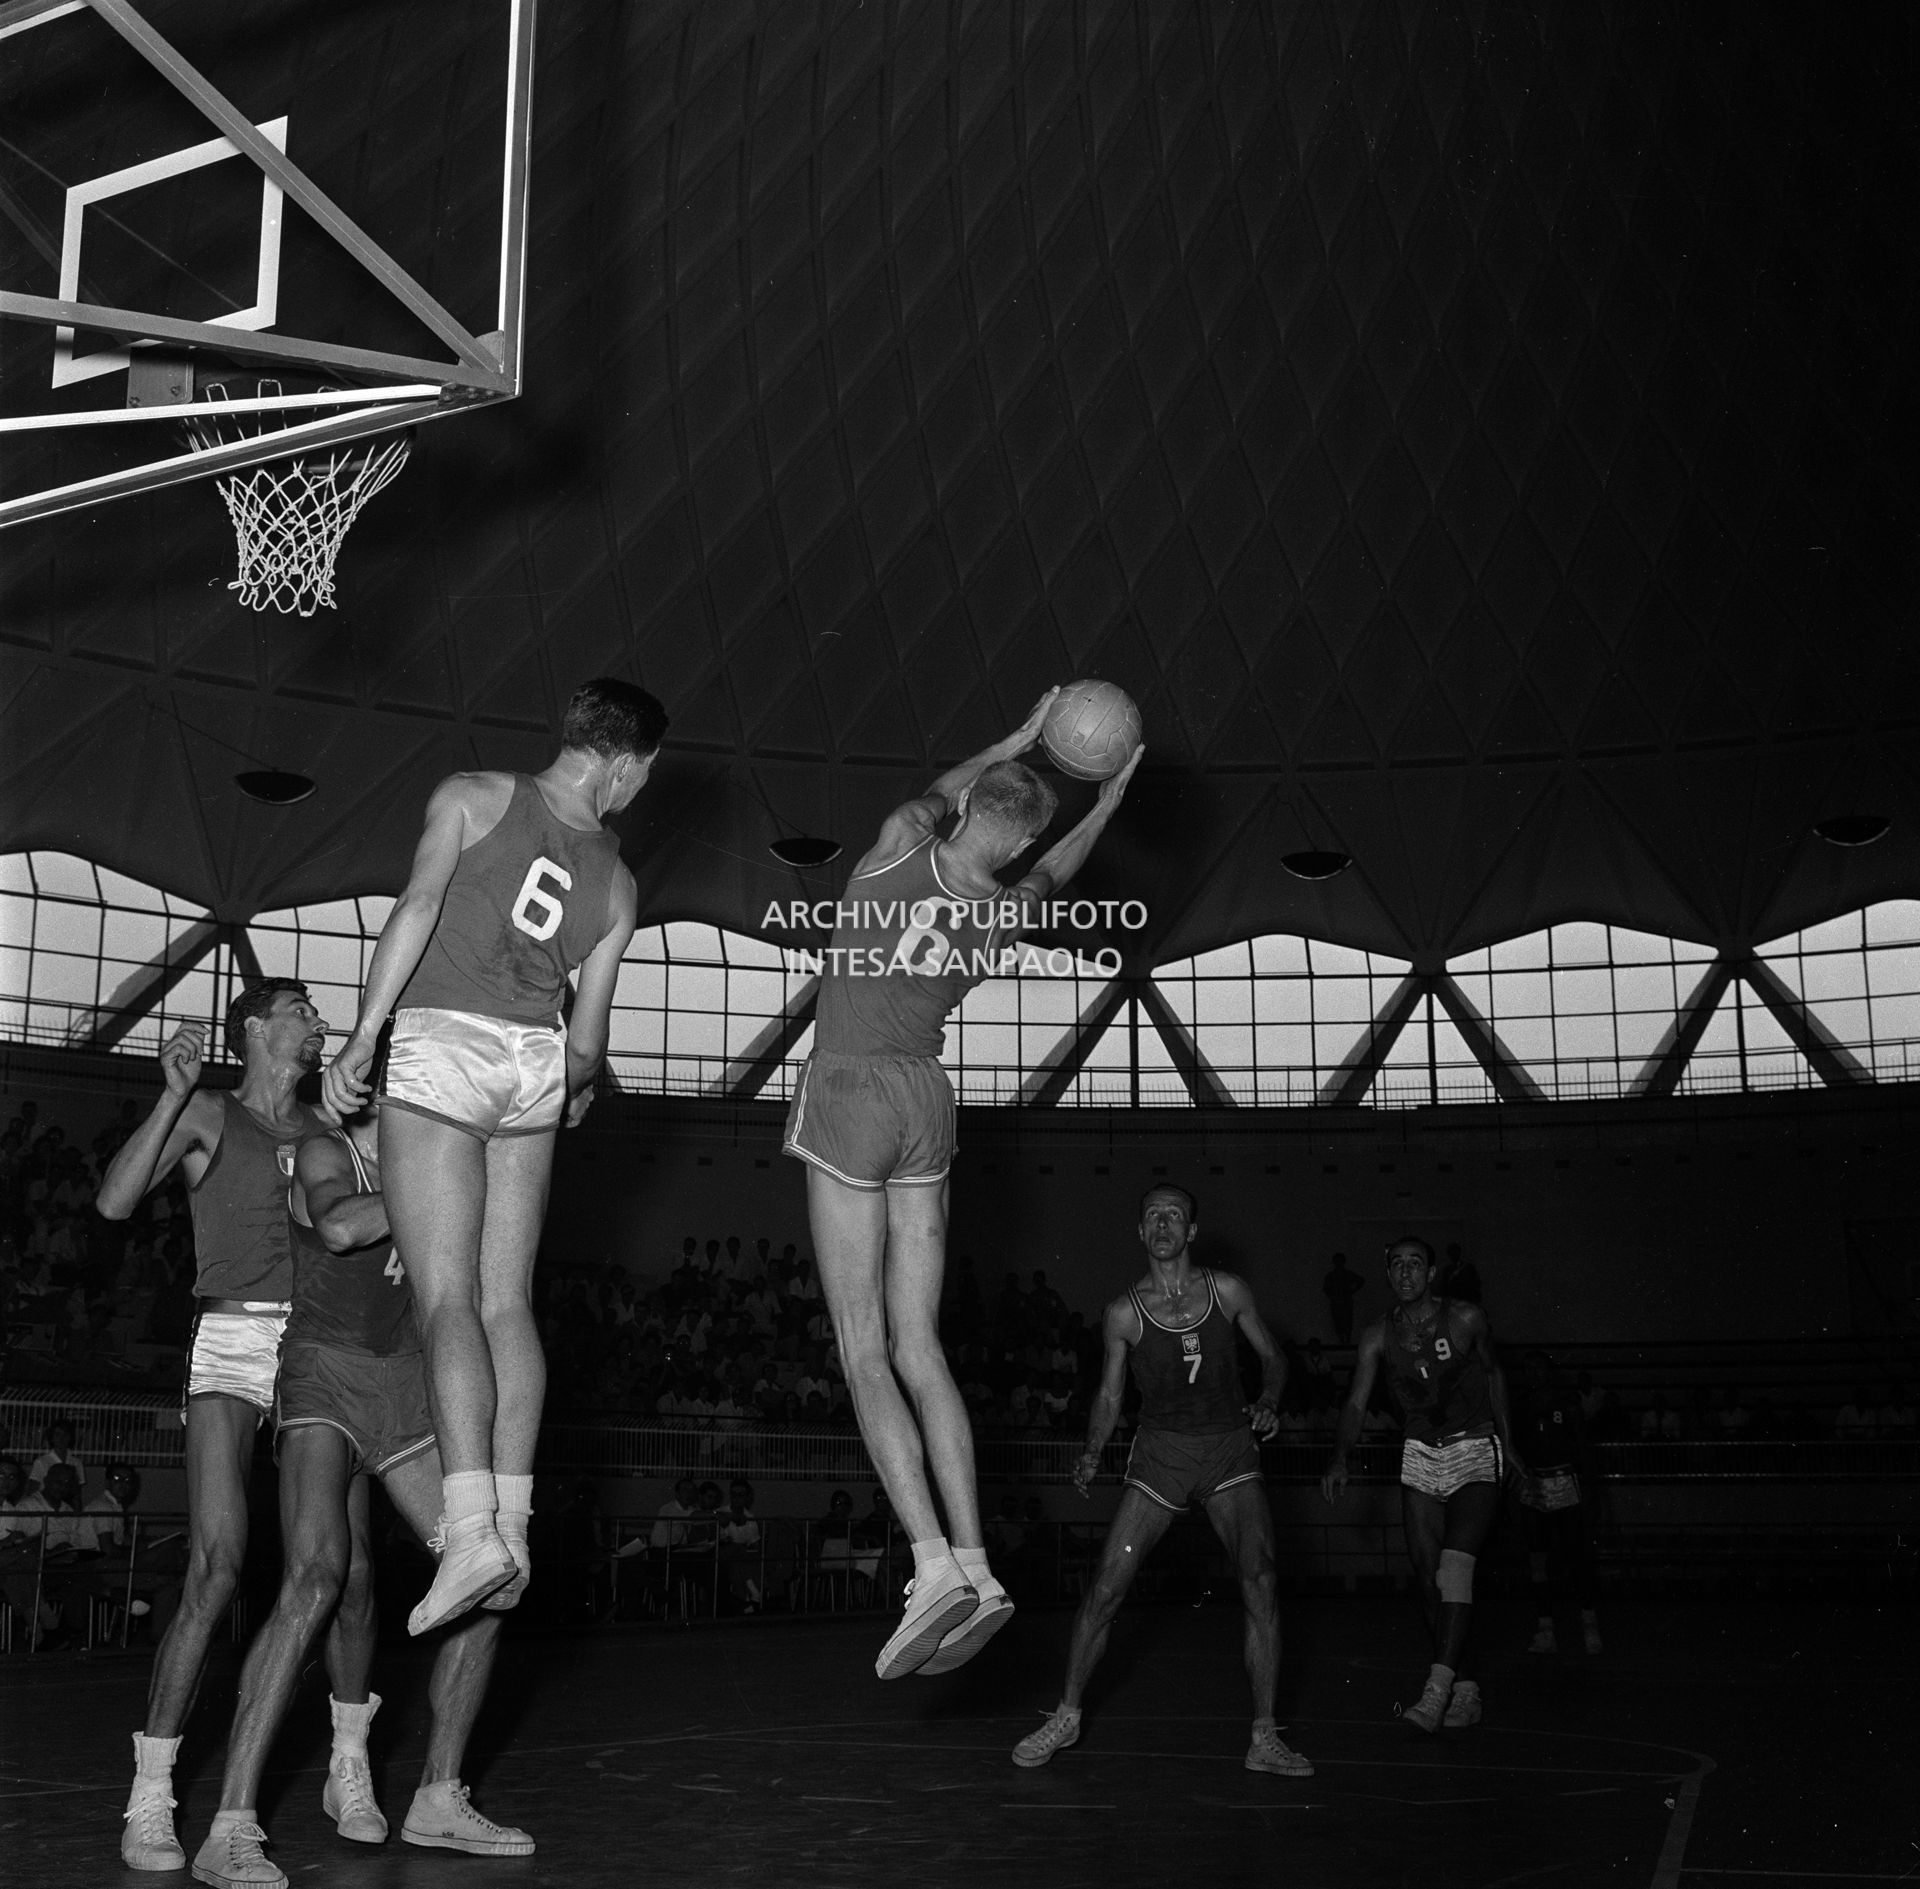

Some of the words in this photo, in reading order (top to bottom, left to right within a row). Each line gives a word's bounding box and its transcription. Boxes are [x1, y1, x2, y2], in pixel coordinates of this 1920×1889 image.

[512, 856, 572, 941] 6
[897, 896, 962, 976] 6
[383, 1246, 406, 1286] 4
[1182, 1353, 1203, 1385] 7
[1434, 1337, 1452, 1361] 9
